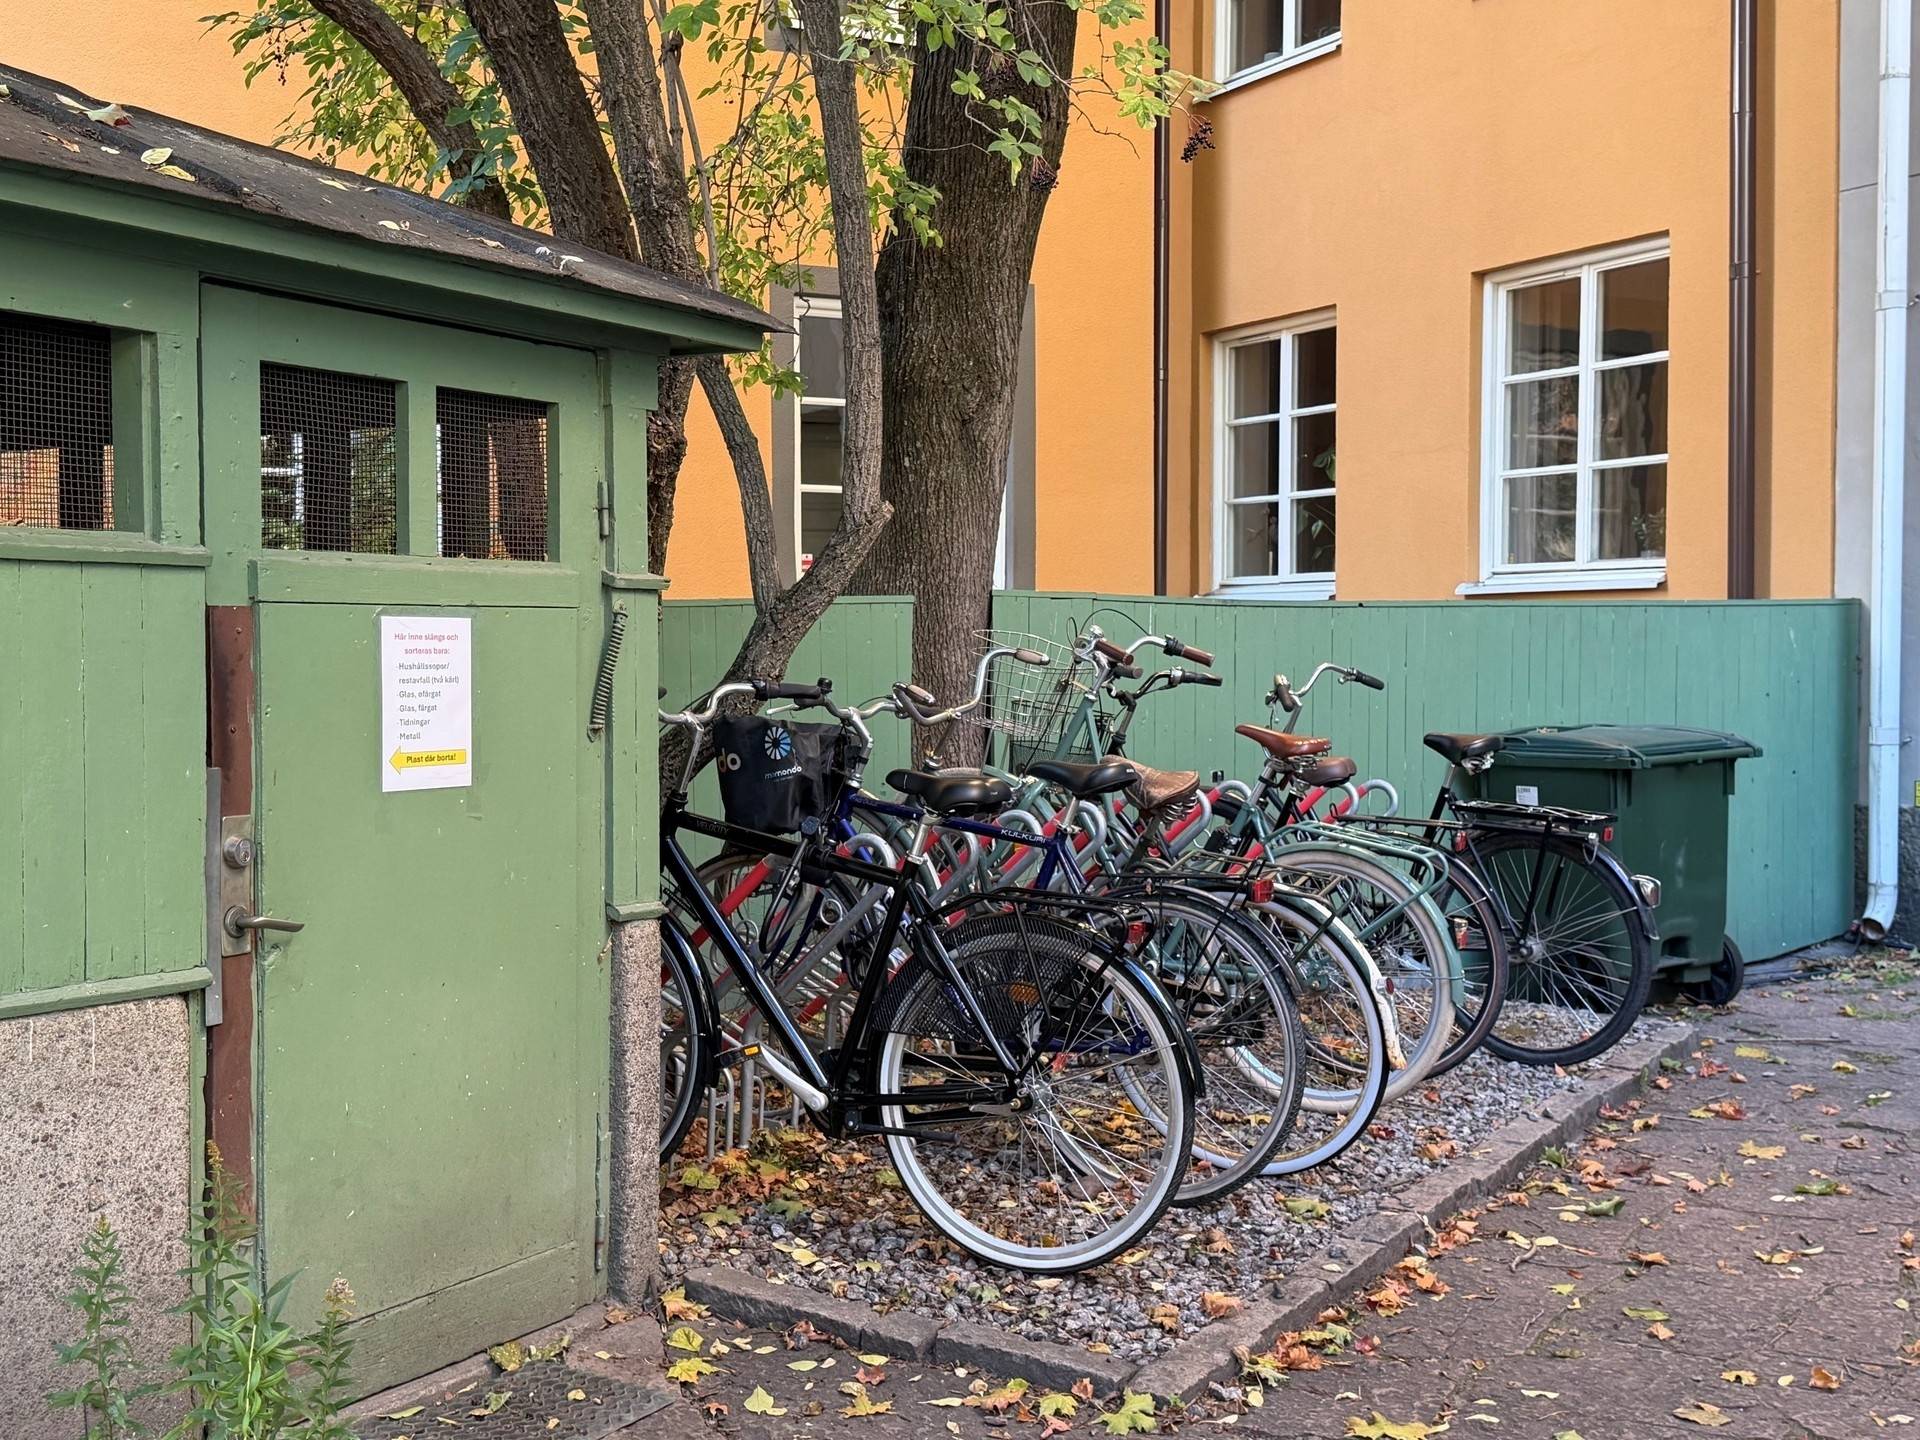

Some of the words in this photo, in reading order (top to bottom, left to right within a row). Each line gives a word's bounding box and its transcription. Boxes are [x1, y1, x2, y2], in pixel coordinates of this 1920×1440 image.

[394, 633, 407, 641] Här
[408, 632, 423, 641] inne
[424, 632, 446, 643] slängs
[446, 633, 459, 641] och
[404, 647, 433, 655] sorteras
[433, 647, 450, 655] bara:
[398, 676, 431, 684] restavfall
[431, 675, 444, 685] (två
[444, 675, 460, 684] kärl)
[399, 690, 417, 699] Glas,
[418, 690, 441, 699] ofärgat
[399, 704, 417, 713] Glas,
[418, 704, 437, 713] färgat
[399, 718, 431, 727] Tidningar
[399, 732, 421, 740] Metall
[406, 755, 424, 764] Plast
[424, 754, 436, 763] där
[436, 753, 457, 762] borta!
[1000, 828, 1047, 843] KULKURI
